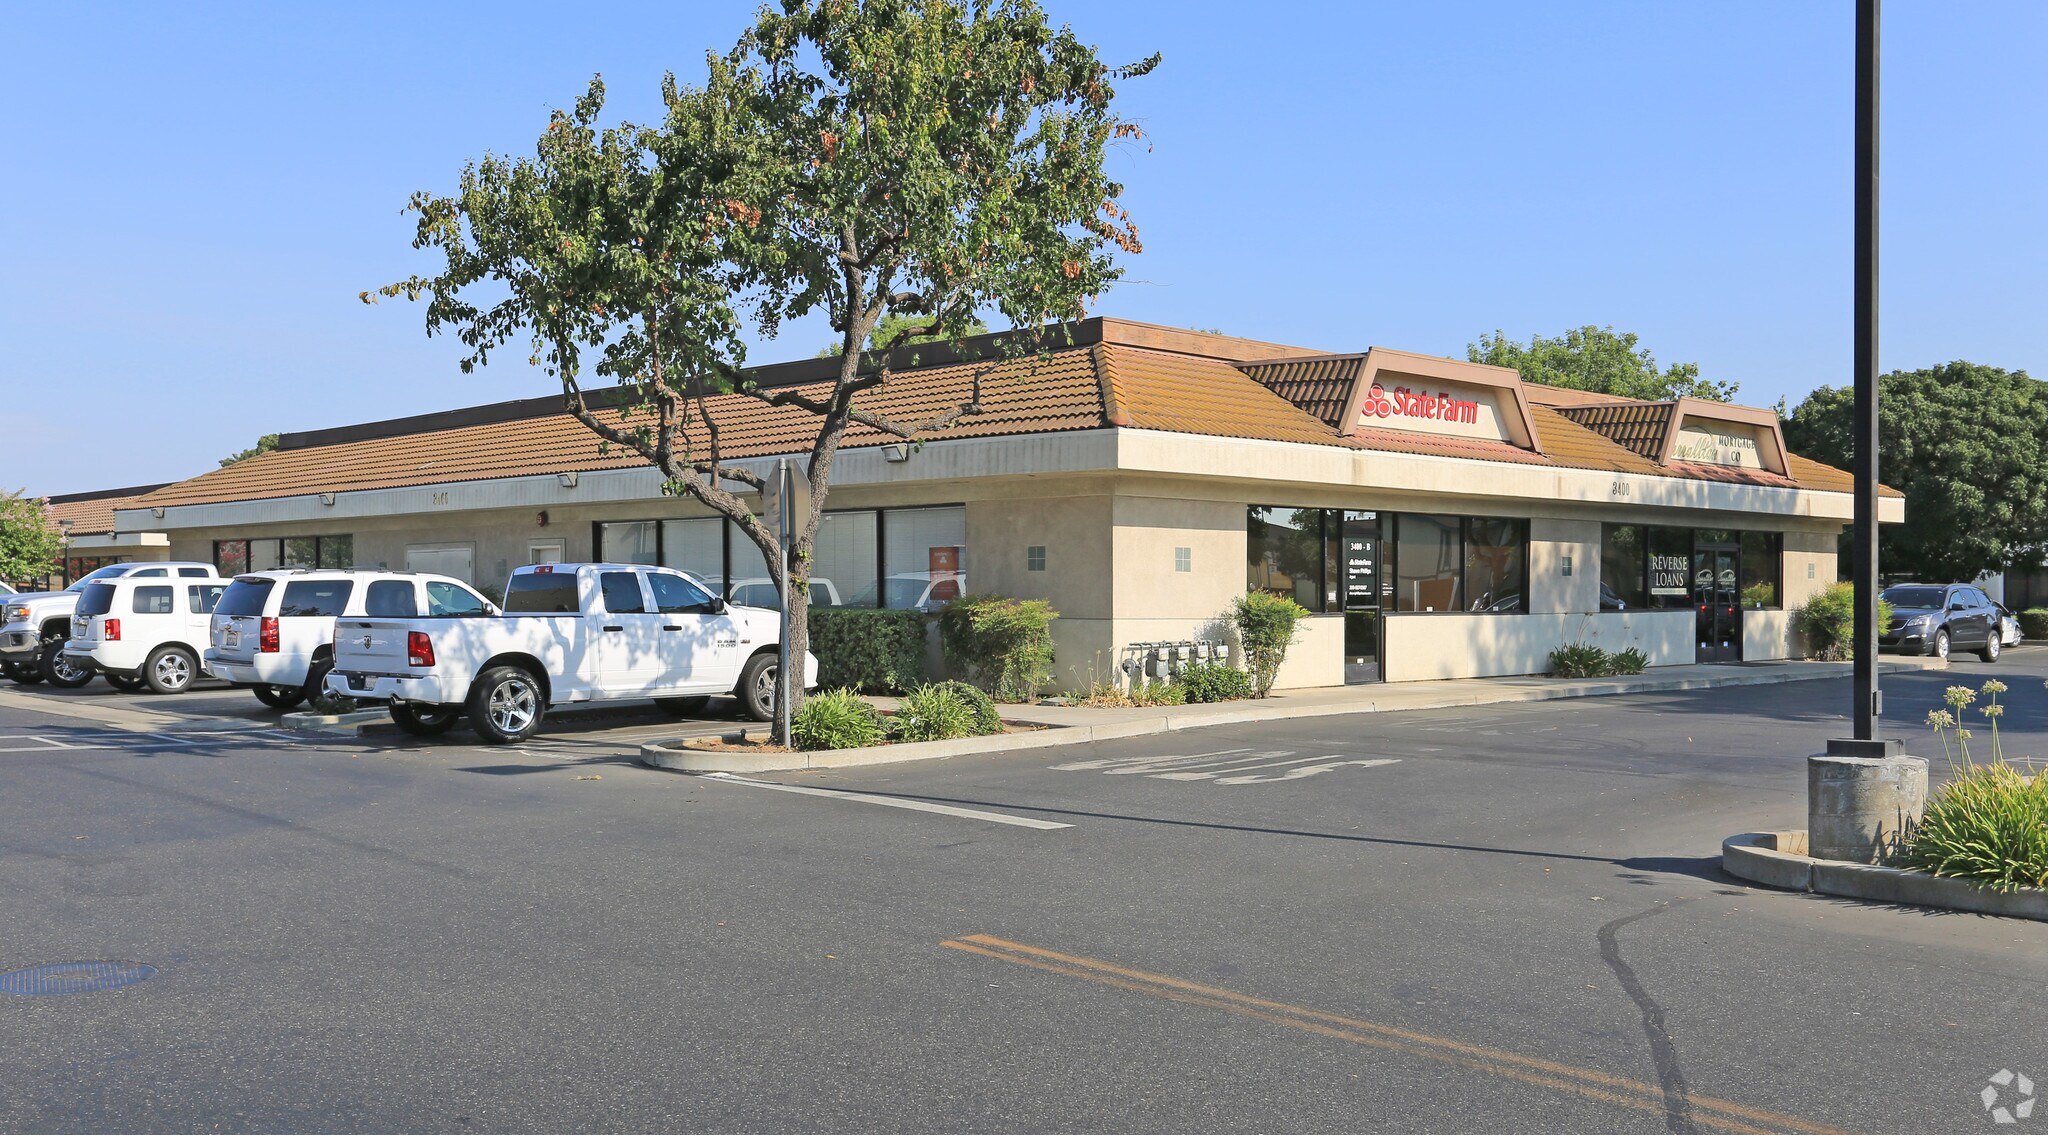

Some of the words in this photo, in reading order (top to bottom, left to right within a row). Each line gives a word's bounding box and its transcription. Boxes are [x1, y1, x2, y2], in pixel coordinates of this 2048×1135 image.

[1393, 386, 1435, 419] State
[1436, 392, 1479, 424] Farm
[1718, 434, 1756, 449] MORTGAGE
[1612, 481, 1630, 496] 3400
[1350, 542, 1362, 551] 3400
[1366, 543, 1371, 551] B
[1652, 556, 1688, 570] REVERSE
[1655, 572, 1684, 587] LOANS
[1046, 748, 1403, 786] STOP
